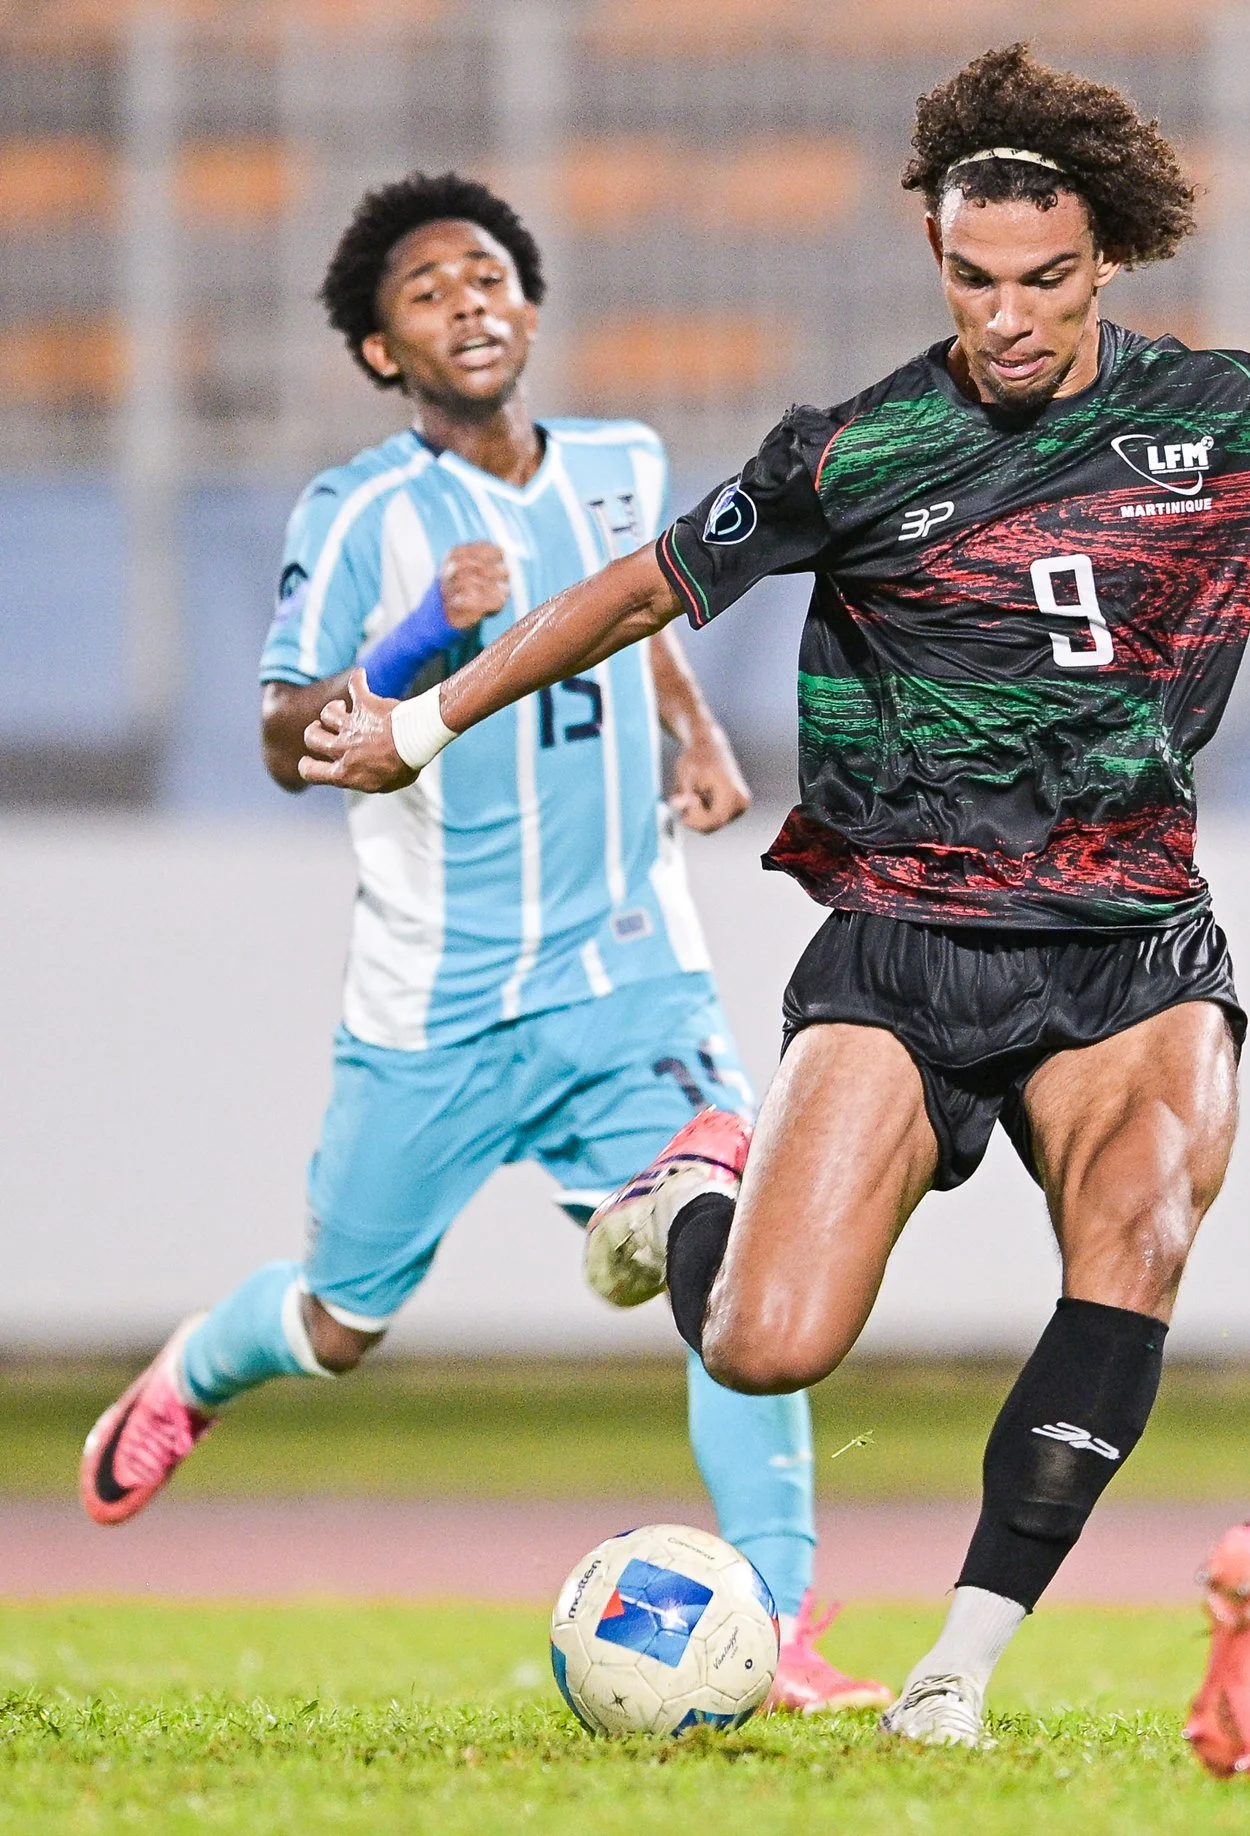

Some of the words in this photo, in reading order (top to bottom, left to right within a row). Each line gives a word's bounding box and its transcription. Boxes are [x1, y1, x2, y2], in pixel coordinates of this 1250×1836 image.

[1148, 439, 1209, 470] LFM
[1120, 498, 1213, 518] MARTINIQUE
[1030, 554, 1115, 668] 9
[568, 1559, 602, 1619] molten
